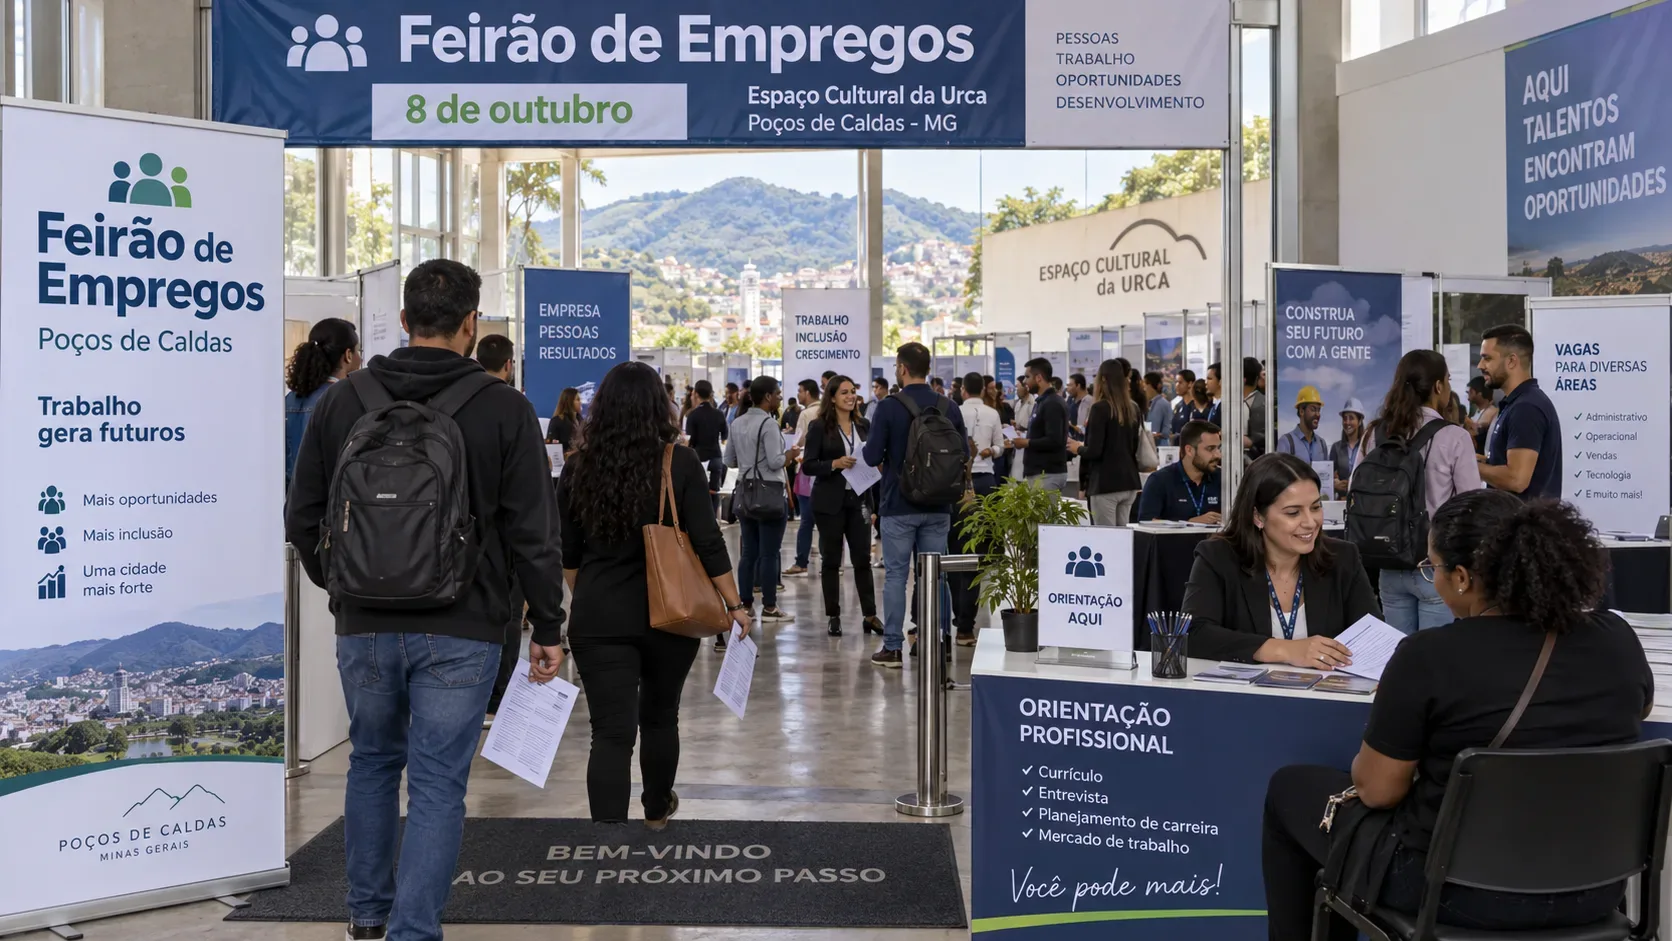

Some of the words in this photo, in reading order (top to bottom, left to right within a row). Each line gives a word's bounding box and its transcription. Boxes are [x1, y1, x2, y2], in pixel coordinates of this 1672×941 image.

[401, 12, 576, 63] Feirão
[591, 14, 662, 62] de
[679, 15, 974, 74] Empregos
[1057, 33, 1118, 44] PESSOAS
[1056, 53, 1134, 65] TRABALHO
[1056, 74, 1181, 86] OPORTUNIDADES
[1523, 64, 1568, 105] AQUI
[748, 86, 819, 109] Espaço
[825, 85, 904, 104] Cultural
[910, 85, 934, 104] da
[942, 86, 986, 104] Urca
[1057, 97, 1204, 108] DESENVOLVIMENTO
[406, 94, 426, 123] 8
[437, 94, 480, 123] de
[490, 94, 633, 124] outubro
[749, 114, 805, 136] Poços
[811, 114, 835, 131] de
[841, 114, 904, 131] Caldas
[925, 114, 956, 131] MG
[1523, 93, 1619, 145] TALENTOS
[1524, 132, 1635, 183] ENCONTRAM
[1524, 166, 1666, 220] OPORTUNIDADES
[38, 211, 185, 260] Feirão
[194, 232, 233, 263] de
[1040, 260, 1090, 281] ESPAÇO
[1096, 249, 1170, 273] CULTURAL
[39, 262, 264, 320] Empregos
[1097, 278, 1115, 296] da
[1122, 272, 1170, 292] URCA
[540, 303, 600, 317] EMPRESA
[1286, 306, 1355, 320] CONSTRUA
[795, 315, 849, 325] TRABALHO
[540, 325, 598, 338] PESSOAS
[796, 330, 847, 342] INCLUSÃO
[1286, 326, 1310, 339] SEU
[1315, 326, 1363, 340] FUTURO
[40, 328, 112, 356] Poços
[121, 329, 150, 351] de
[159, 330, 232, 352] Caldas
[1555, 343, 1599, 355] VAGAS
[540, 347, 616, 359] RESULTADOS
[796, 350, 860, 359] CRESCIMENTO
[1286, 345, 1315, 358] COM
[1319, 346, 1327, 359] A
[1331, 346, 1370, 359] GENTE
[1556, 361, 1586, 372] PARA
[1590, 361, 1647, 372] DIVERSAS
[1555, 376, 1596, 391] ÁREAS
[38, 396, 141, 416] Trabalho
[1586, 413, 1647, 421] Administrativo
[39, 428, 92, 448] gera
[100, 422, 185, 442] futuros
[1586, 432, 1637, 443] Operacional
[1586, 452, 1617, 460] Vendas
[1586, 470, 1631, 481] Tecnologia
[84, 494, 114, 506] Mais
[119, 491, 217, 508] oportunidades
[1586, 490, 1591, 498] E
[1621, 491, 1642, 499] mais!
[84, 529, 114, 541] Mais
[120, 527, 172, 540] inclusão
[84, 565, 115, 577] Uma
[120, 562, 166, 575] cidade
[84, 583, 115, 596] mais
[120, 582, 152, 594] forte
[1049, 593, 1122, 609] ORIENTAÇÃO
[1068, 612, 1101, 626] AQUI
[1019, 698, 1171, 729] ORIENTAÇÃO
[1020, 724, 1173, 754] PROFISSIONAL
[1039, 766, 1102, 782] Currículo
[1040, 787, 1108, 804] Entrevista
[1040, 808, 1136, 827] Planejamento
[1140, 816, 1158, 829] de
[1163, 821, 1218, 835] carreira
[60, 832, 120, 851] POÇOS
[131, 827, 150, 841] DE
[161, 816, 226, 836] CALDAS
[1040, 829, 1101, 845] Mercado
[1106, 834, 1124, 848] de
[1128, 838, 1189, 854] trabalho
[100, 848, 139, 861] MINAS
[146, 840, 188, 854] GERAIS
[547, 845, 771, 860] BEM-VINDO
[452, 871, 504, 885] AO
[515, 870, 584, 884] SEU
[595, 866, 762, 883] PRÓXIMO
[774, 868, 885, 882] PASSO
[1012, 867, 1066, 902] Você
[1072, 868, 1136, 912] pode
[1146, 863, 1223, 895] mais!
